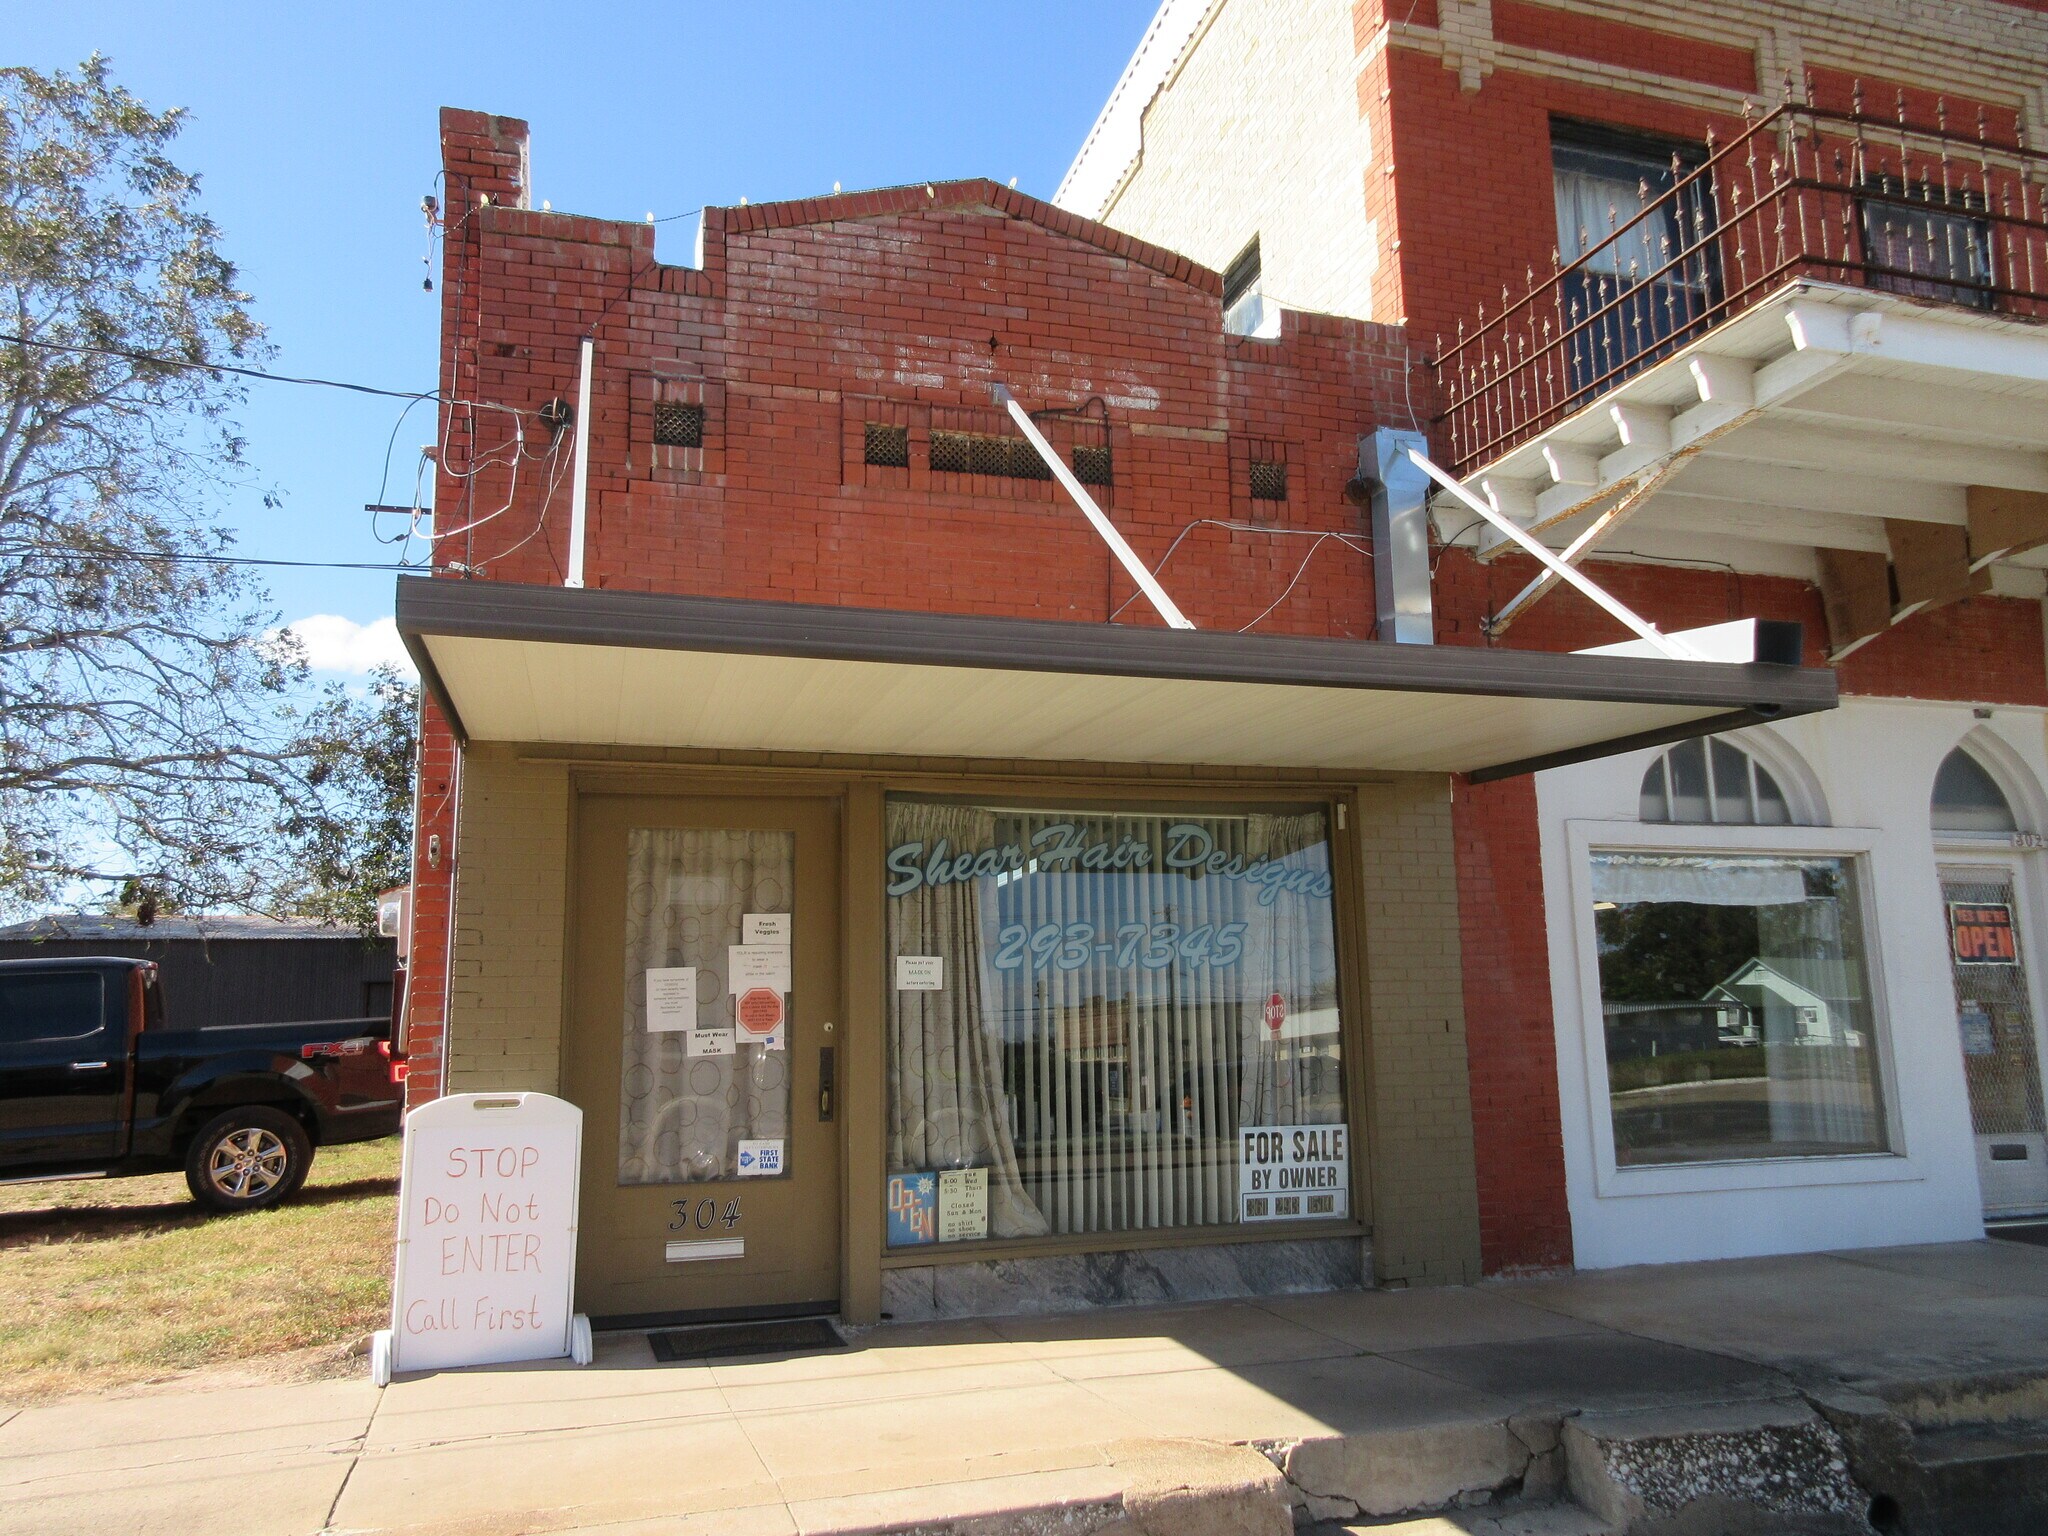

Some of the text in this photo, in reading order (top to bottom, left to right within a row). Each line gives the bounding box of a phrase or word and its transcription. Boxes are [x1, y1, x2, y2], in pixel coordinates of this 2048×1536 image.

[887, 823, 1332, 906] Shear Hair Designs
[994, 922, 1248, 969] 293-7345
[1956, 926, 2015, 957] OPEN
[302, 1040, 364, 1058] FX4
[446, 1147, 540, 1178] STOP
[1244, 1129, 1344, 1165] FOR SALE
[1251, 1166, 1338, 1190] BY OWNER
[424, 1193, 540, 1227] Do Not
[668, 1195, 742, 1231] 304
[890, 1179, 934, 1239] OPEN
[441, 1232, 543, 1276] ENTER
[405, 1294, 543, 1335] Call First
